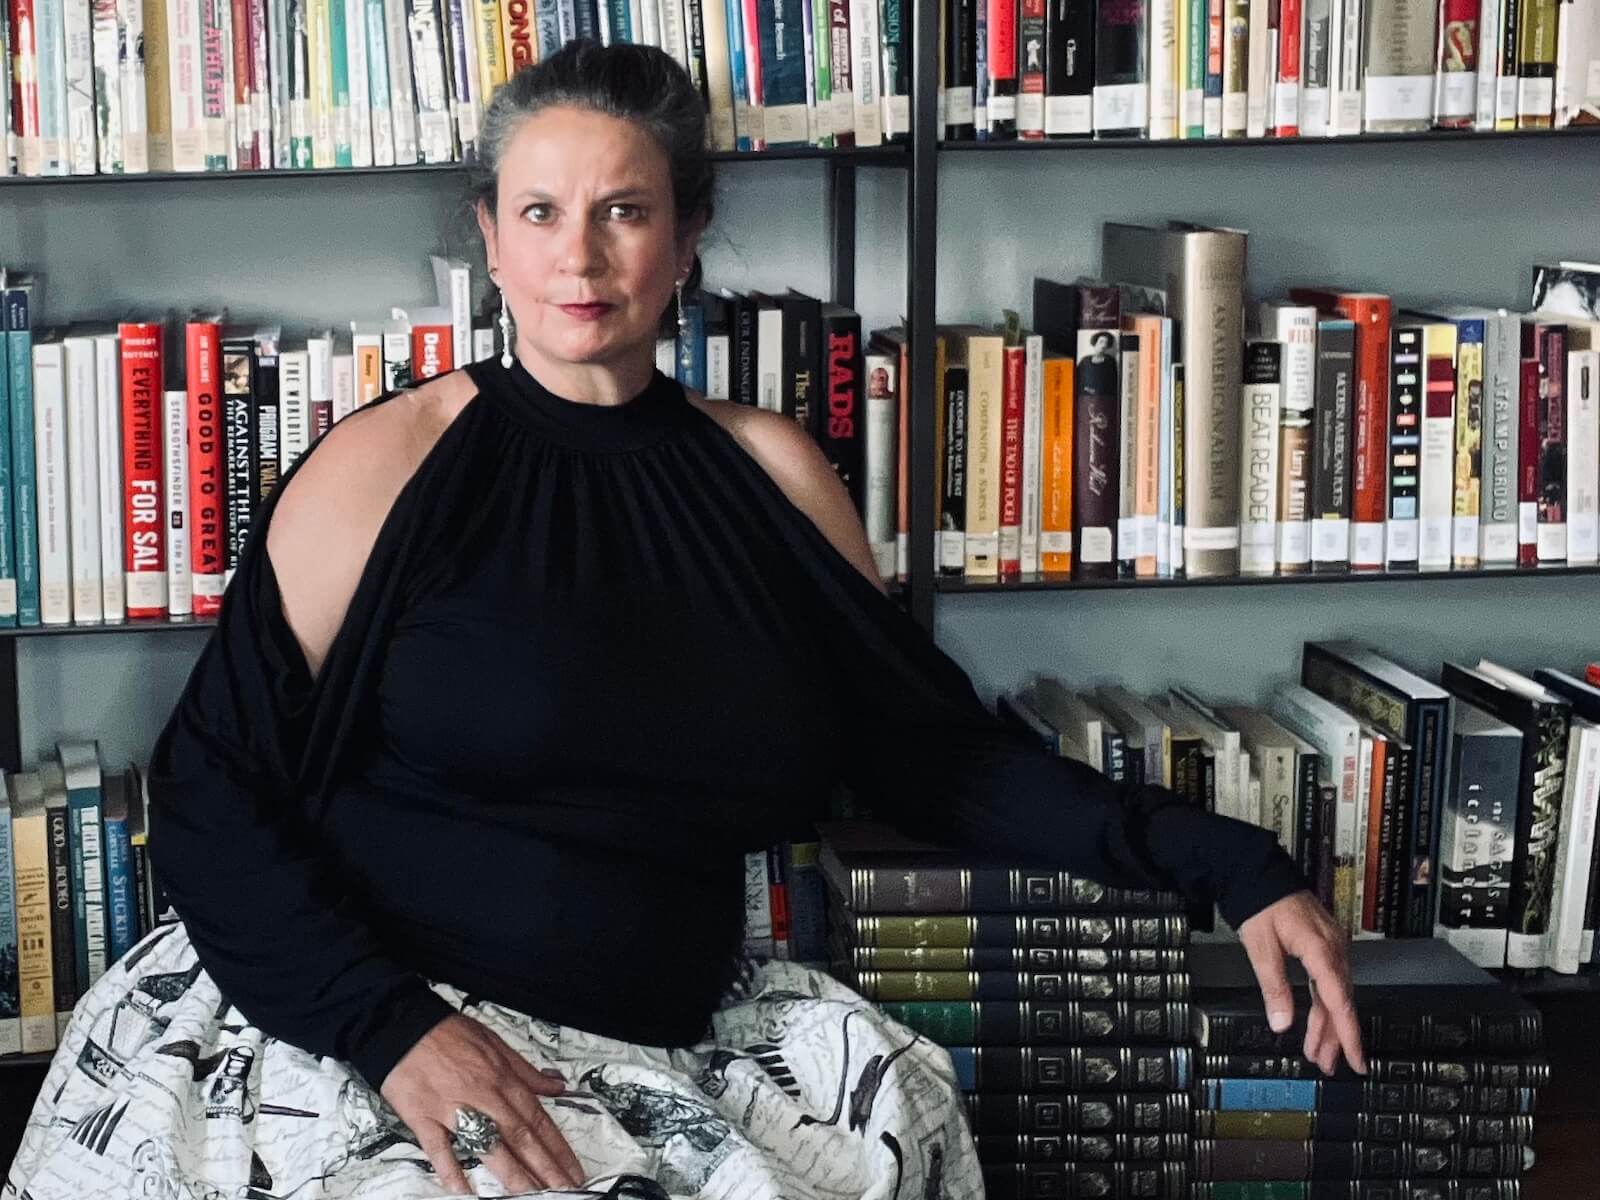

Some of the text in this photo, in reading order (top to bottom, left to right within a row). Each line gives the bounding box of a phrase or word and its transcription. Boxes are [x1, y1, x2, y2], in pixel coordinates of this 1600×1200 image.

[832, 9, 847, 24] of
[203, 28, 224, 117] ATHLETE
[421, 332, 439, 378] Desig
[741, 341, 751, 403] ENDANGE
[285, 361, 302, 444] THE WORLDLY
[795, 371, 810, 400] The
[795, 402, 810, 422] Ti
[828, 331, 854, 439] RADS
[1210, 305, 1226, 500] AN AMERICAN ALBUM
[1335, 372, 1346, 420] MODERN
[198, 392, 213, 454] GOOD
[235, 398, 253, 481] AGAINST
[1006, 417, 1018, 443] THE
[1251, 393, 1271, 443] BEAT
[131, 367, 159, 573] EVERYTHING FOR SAL
[170, 401, 184, 506] STRENGTHSFINDER
[259, 405, 278, 502] PROGRAM EVALU
[1333, 421, 1344, 475] AMERICAN
[1492, 375, 1509, 521] A TRAMP ABROAD
[200, 466, 214, 495] TO
[226, 400, 238, 571] THE REMARKABLE STORY OF RI
[238, 484, 251, 524] THE
[174, 562, 182, 576] RA
[1111, 738, 1125, 782] LARR
[53, 817, 65, 847] GOD
[55, 866, 69, 910] RODEO
[1488, 831, 1507, 899] SAGAS
